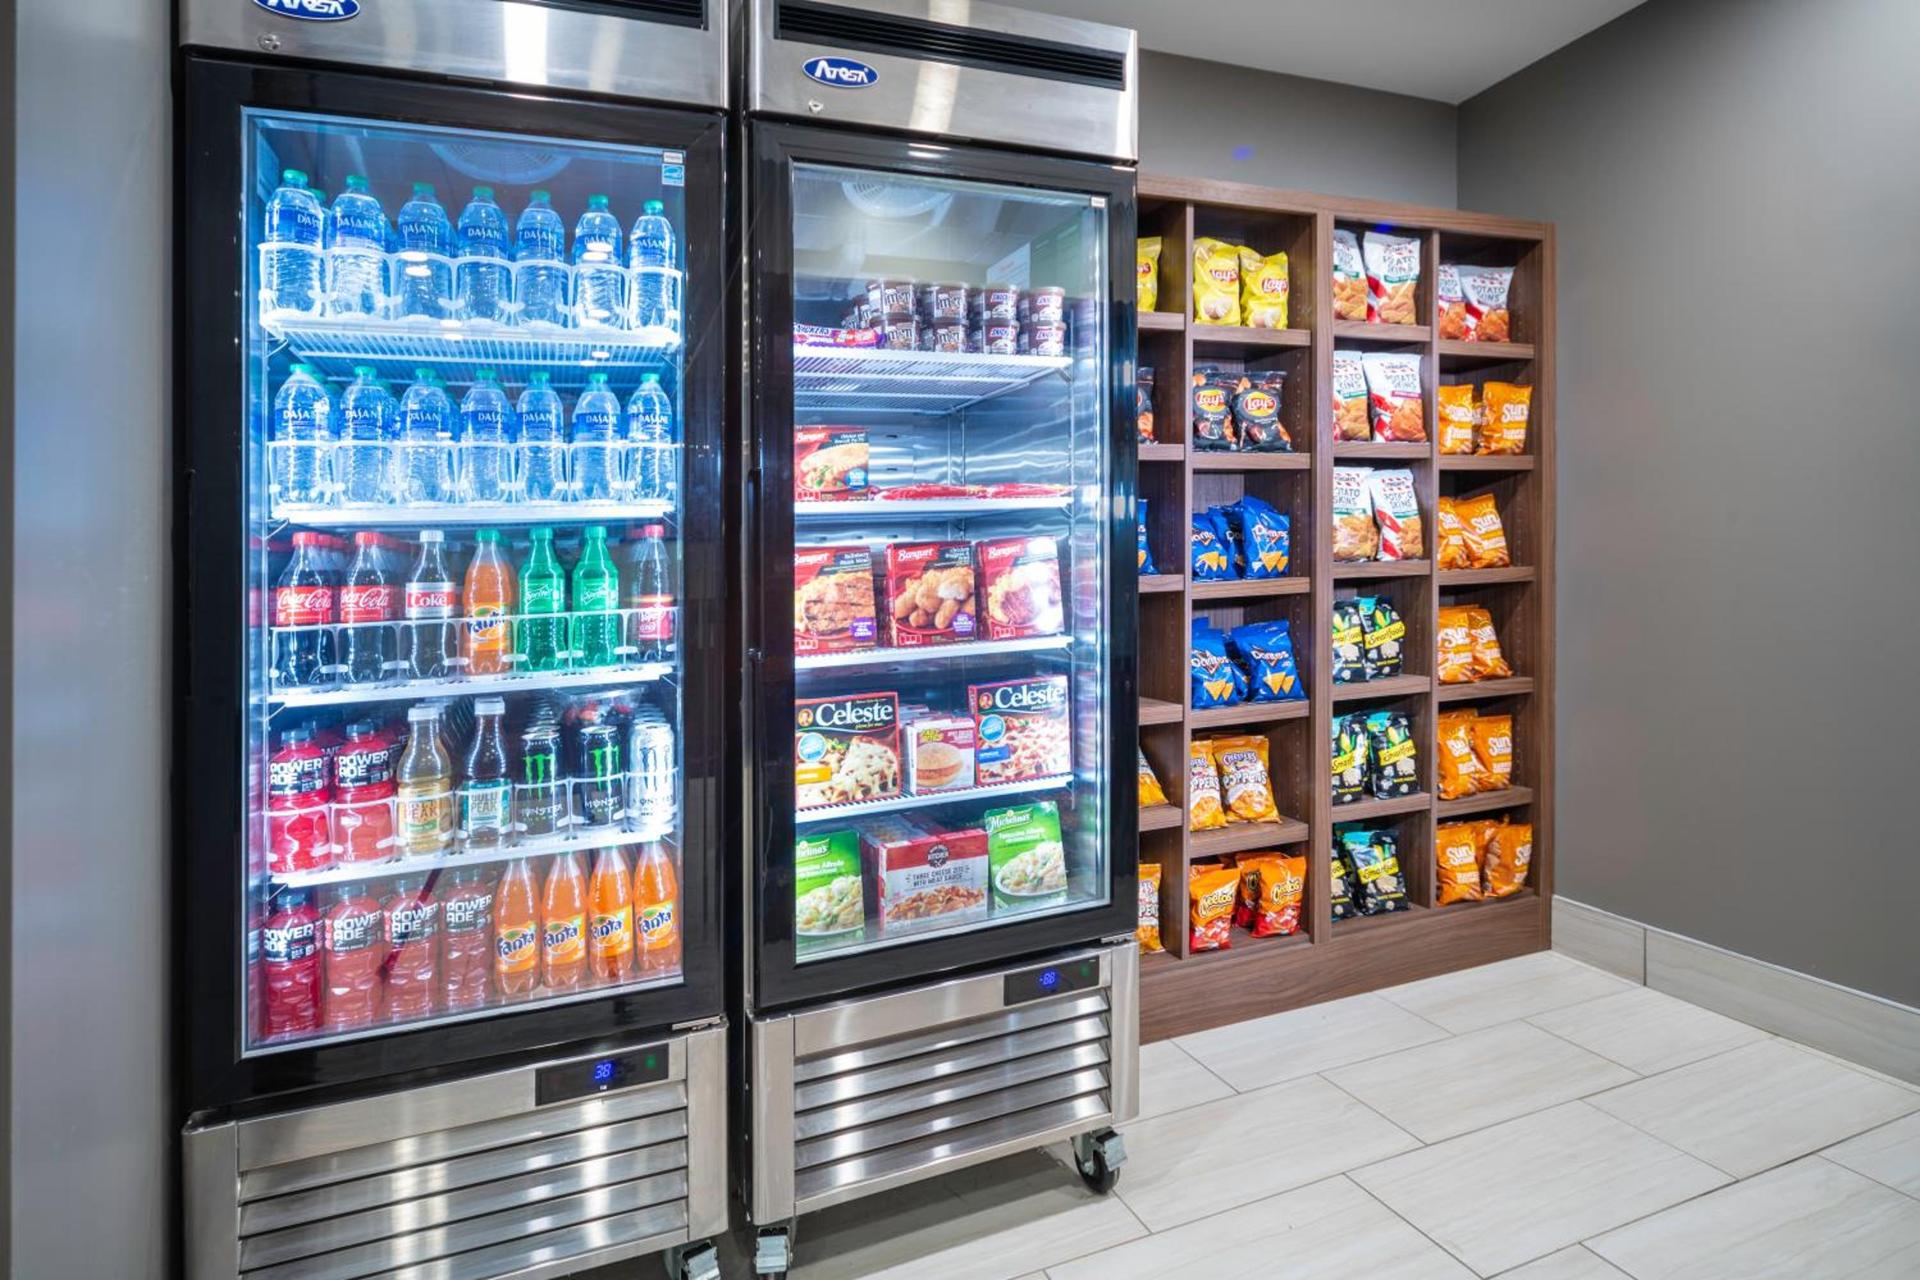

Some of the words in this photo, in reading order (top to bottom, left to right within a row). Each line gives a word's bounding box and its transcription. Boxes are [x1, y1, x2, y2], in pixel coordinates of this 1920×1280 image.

[1247, 396, 1274, 410] Lay's
[410, 592, 448, 608] Coke
[995, 684, 1065, 709] Celeste
[815, 701, 893, 726] Celeste
[270, 758, 322, 774] POWER
[338, 750, 389, 767] POWER
[446, 894, 492, 912] POWER
[637, 910, 671, 933] Fanta
[496, 931, 535, 957] Fanta
[543, 924, 578, 948] Fanta
[594, 1063, 612, 1079] 38
